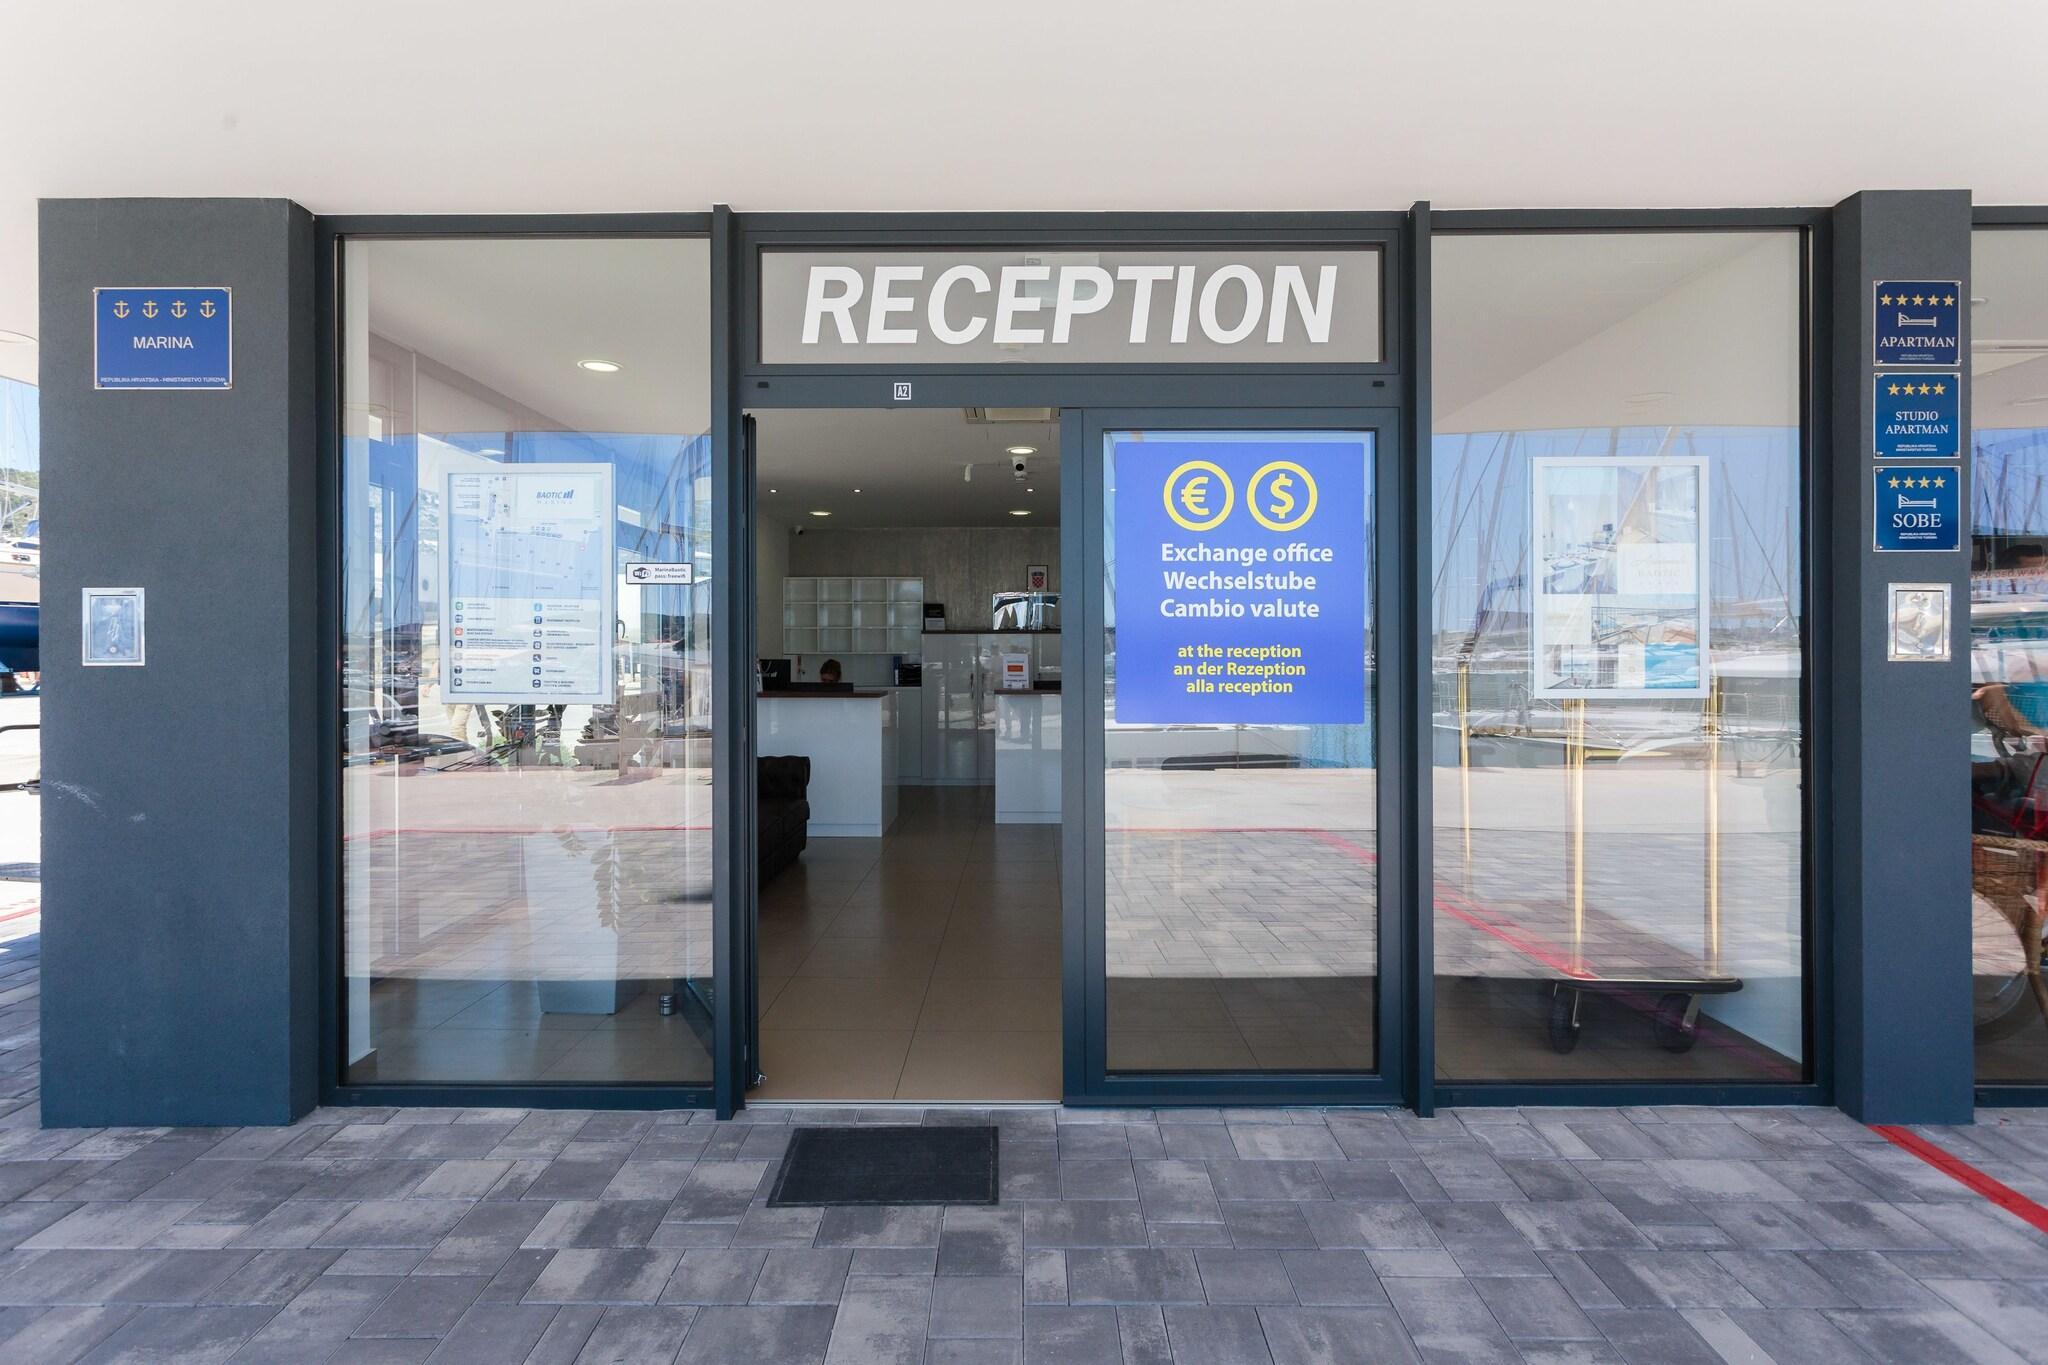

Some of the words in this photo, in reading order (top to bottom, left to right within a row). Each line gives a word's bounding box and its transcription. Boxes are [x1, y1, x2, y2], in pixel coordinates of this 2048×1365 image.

[801, 265, 1337, 344] RECEPTION
[133, 336, 194, 349] MARINA
[1880, 336, 1956, 348] APARTMAN
[897, 385, 908, 397] A2
[1895, 411, 1939, 421] STUDIO
[1885, 424, 1949, 434] APARTMAN
[536, 491, 563, 499] BAOTIC
[1892, 513, 1942, 528] SOBE
[1161, 543, 1268, 566] Exchange
[1273, 543, 1333, 562] office
[1163, 571, 1316, 590] Wechselstube
[1160, 599, 1245, 617] Cambio
[1250, 599, 1320, 617] valute
[1178, 645, 1194, 658] at
[1197, 644, 1223, 658] the
[1227, 644, 1302, 661] reception
[1173, 665, 1193, 675] an
[1197, 661, 1223, 675] der
[1227, 662, 1306, 679] Rezeption
[1186, 679, 1215, 693] alla
[1218, 679, 1293, 696] reception
